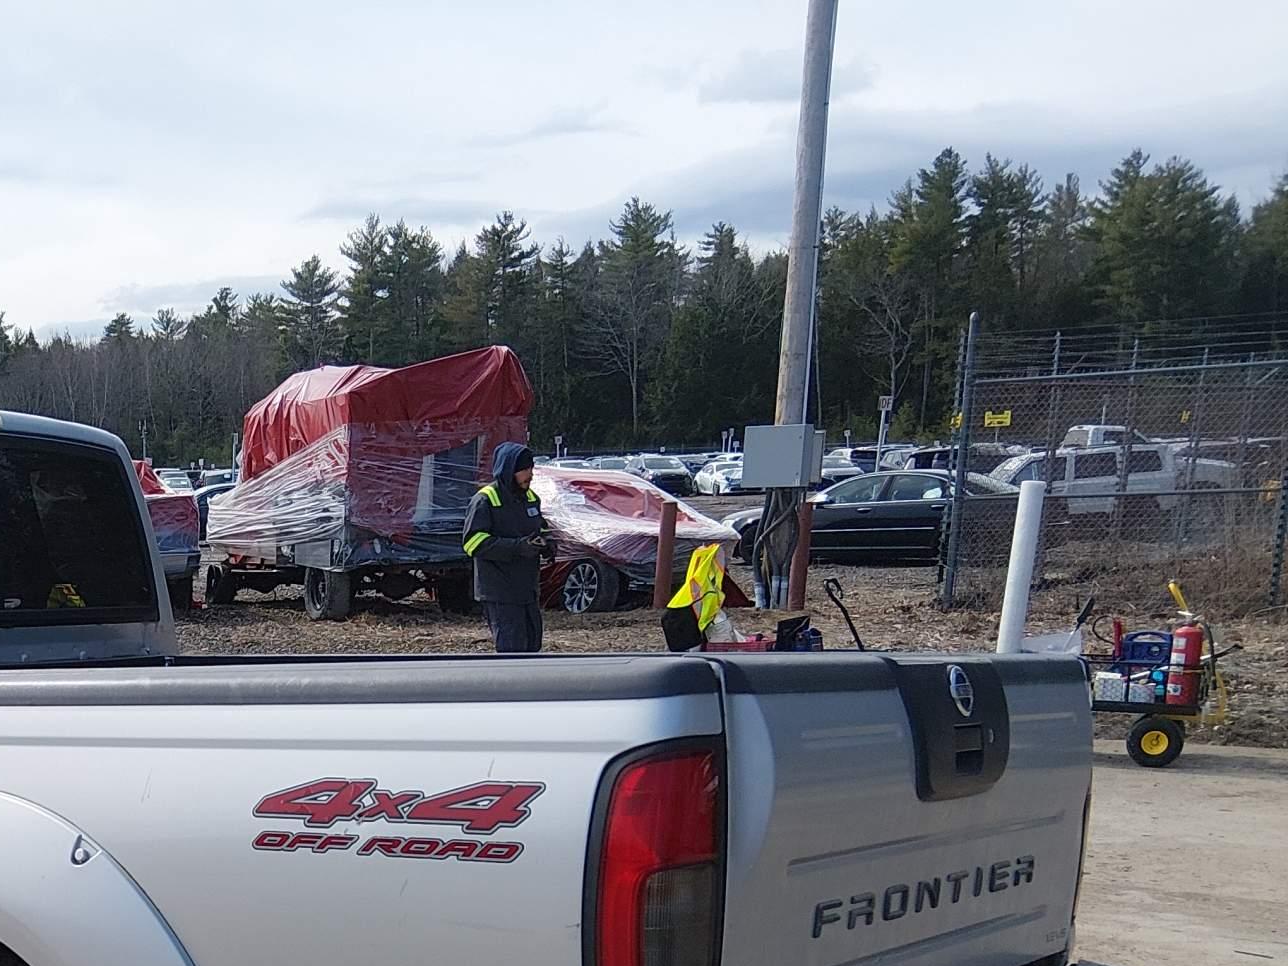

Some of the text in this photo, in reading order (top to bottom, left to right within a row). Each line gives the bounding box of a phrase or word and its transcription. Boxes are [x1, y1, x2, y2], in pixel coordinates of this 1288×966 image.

[252, 831, 524, 864] OFF ROAD
[812, 855, 1035, 938] FRONTIER
